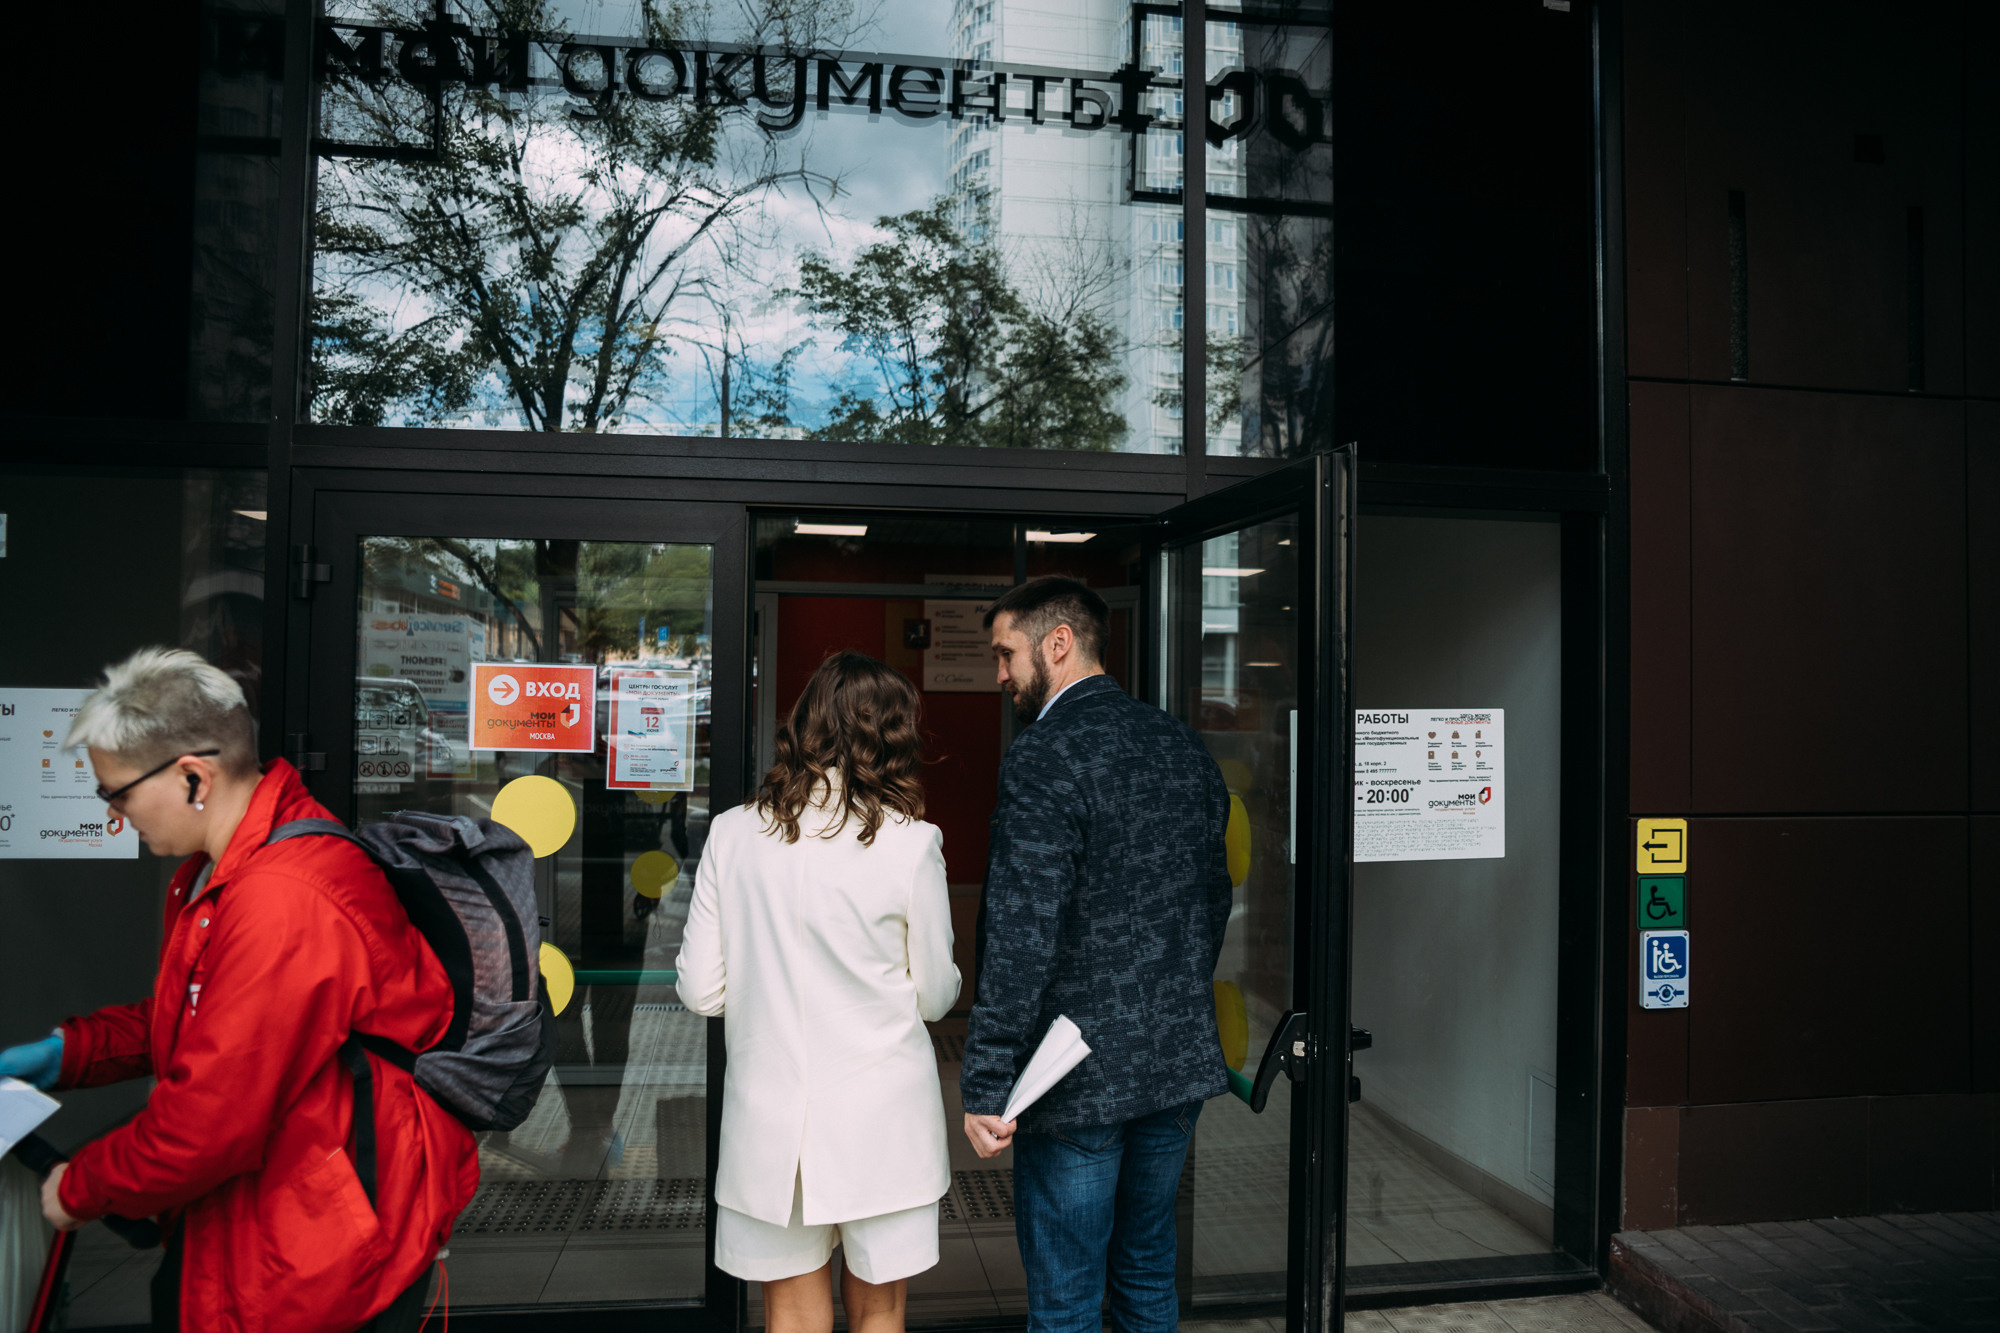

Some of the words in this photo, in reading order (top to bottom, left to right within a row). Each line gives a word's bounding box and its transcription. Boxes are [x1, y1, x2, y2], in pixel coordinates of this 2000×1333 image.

[556, 40, 1139, 134] документы
[526, 681, 581, 700] ВХОД
[530, 712, 556, 720] мои
[1357, 713, 1409, 724] РАБОТЫ
[487, 718, 556, 730] документы
[645, 716, 660, 728] 12
[529, 732, 556, 740] МОСКВА
[1370, 779, 1421, 787] воскресенье
[1428, 799, 1476, 809] документы
[40, 829, 103, 840] документы
